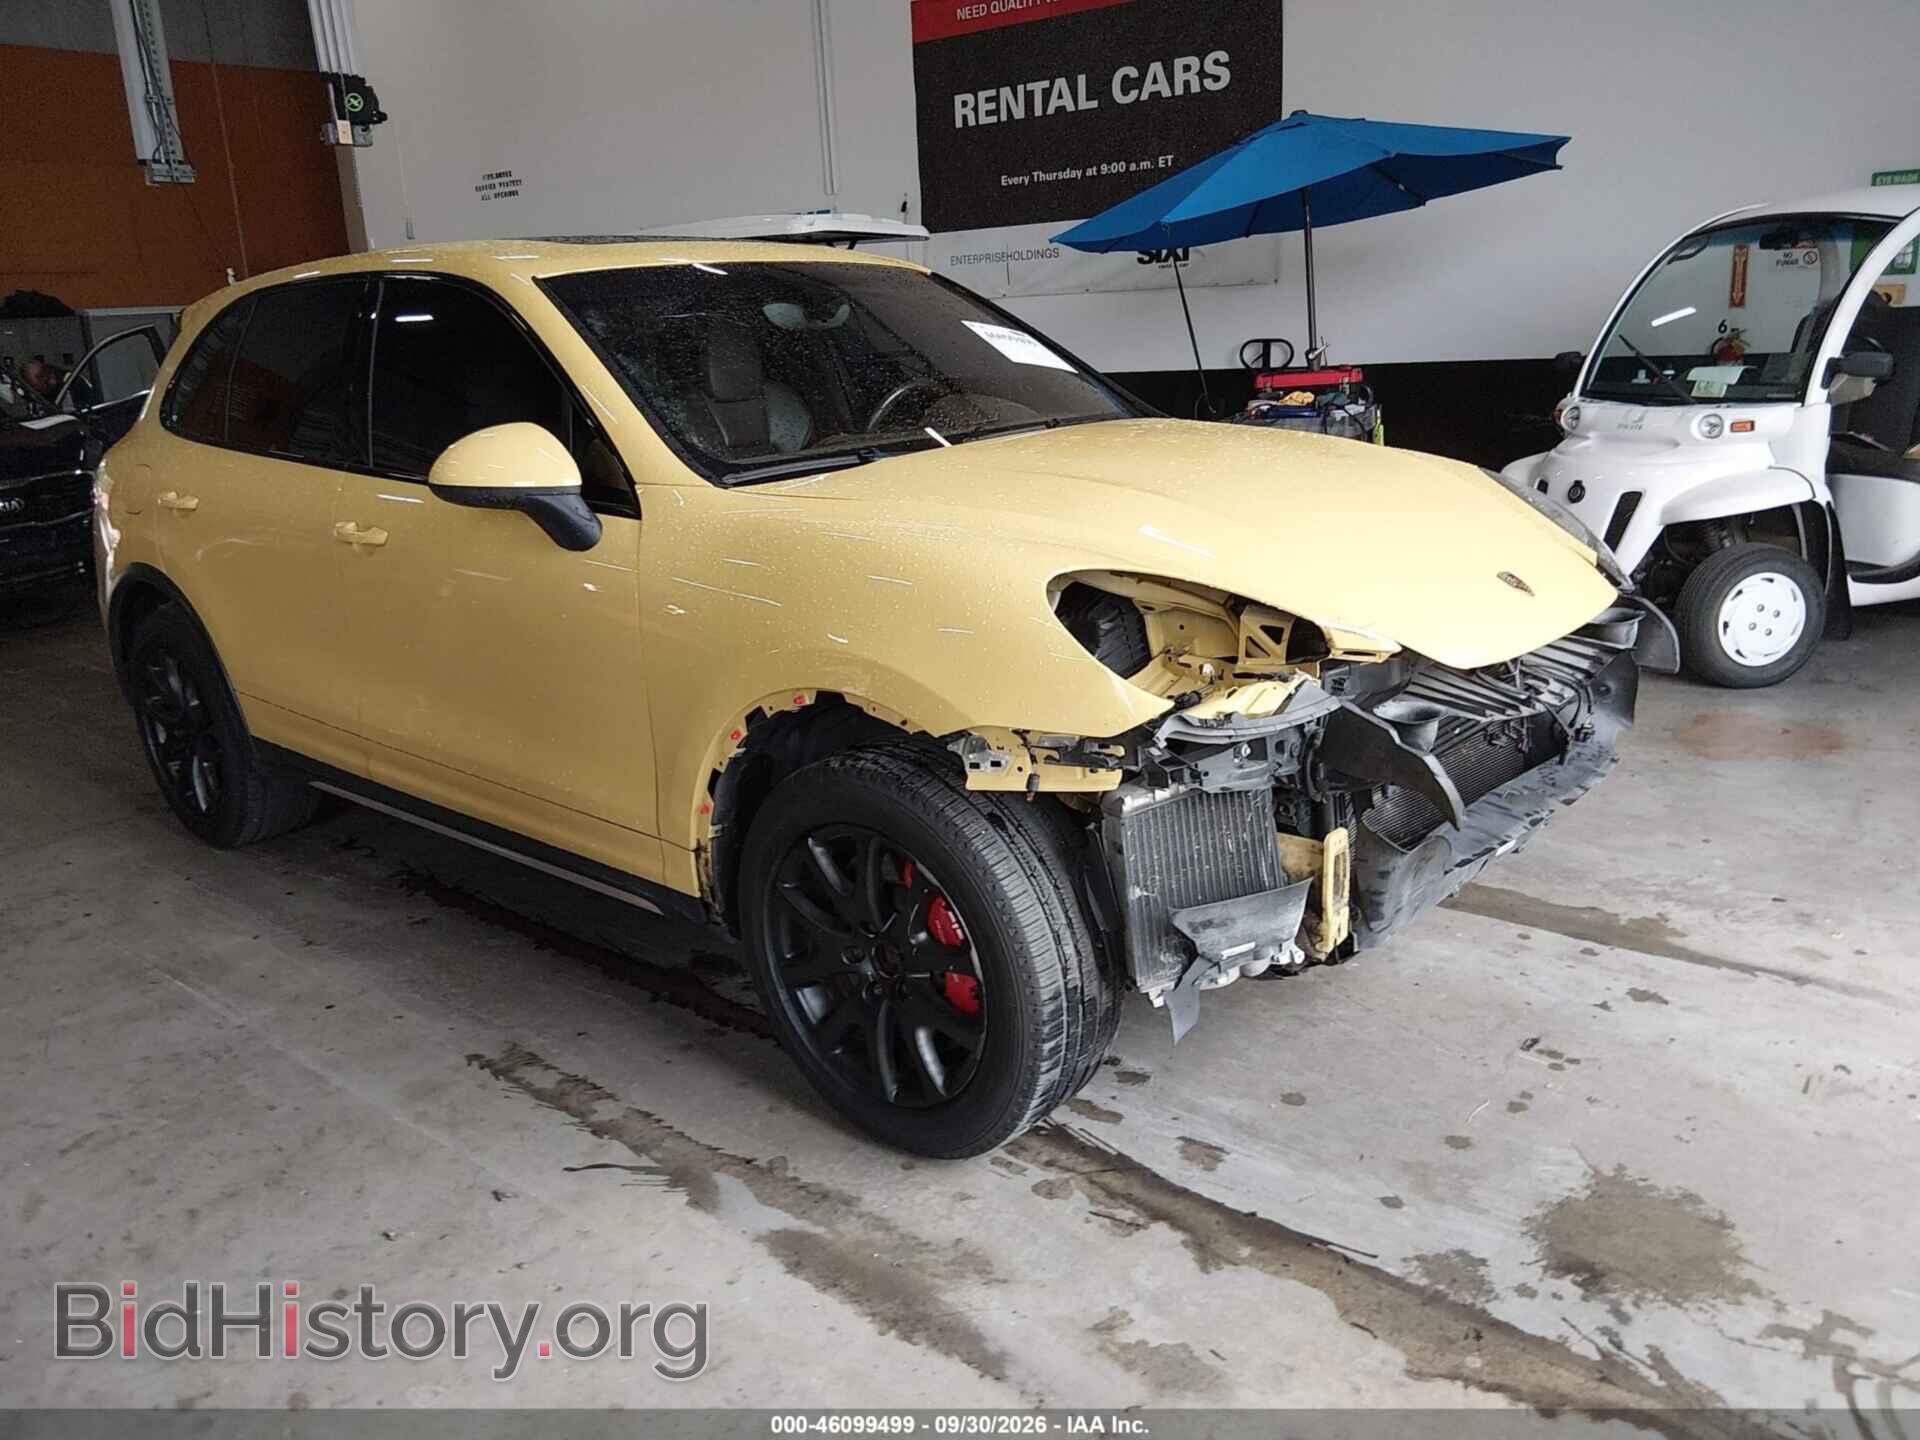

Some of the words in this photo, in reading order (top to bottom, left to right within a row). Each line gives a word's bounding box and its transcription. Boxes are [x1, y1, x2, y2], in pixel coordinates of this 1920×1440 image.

[956, 3, 987, 21] NEED
[954, 74, 1098, 128] RENTAL
[1111, 50, 1231, 104] CARS
[1000, 174, 1030, 187] Every
[1032, 168, 1083, 184] Thursday
[1085, 166, 1098, 176] at
[1100, 161, 1127, 176] 9:00
[1129, 160, 1155, 173] a.m.
[1157, 155, 1175, 168] ET
[1718, 319, 1728, 334] 6
